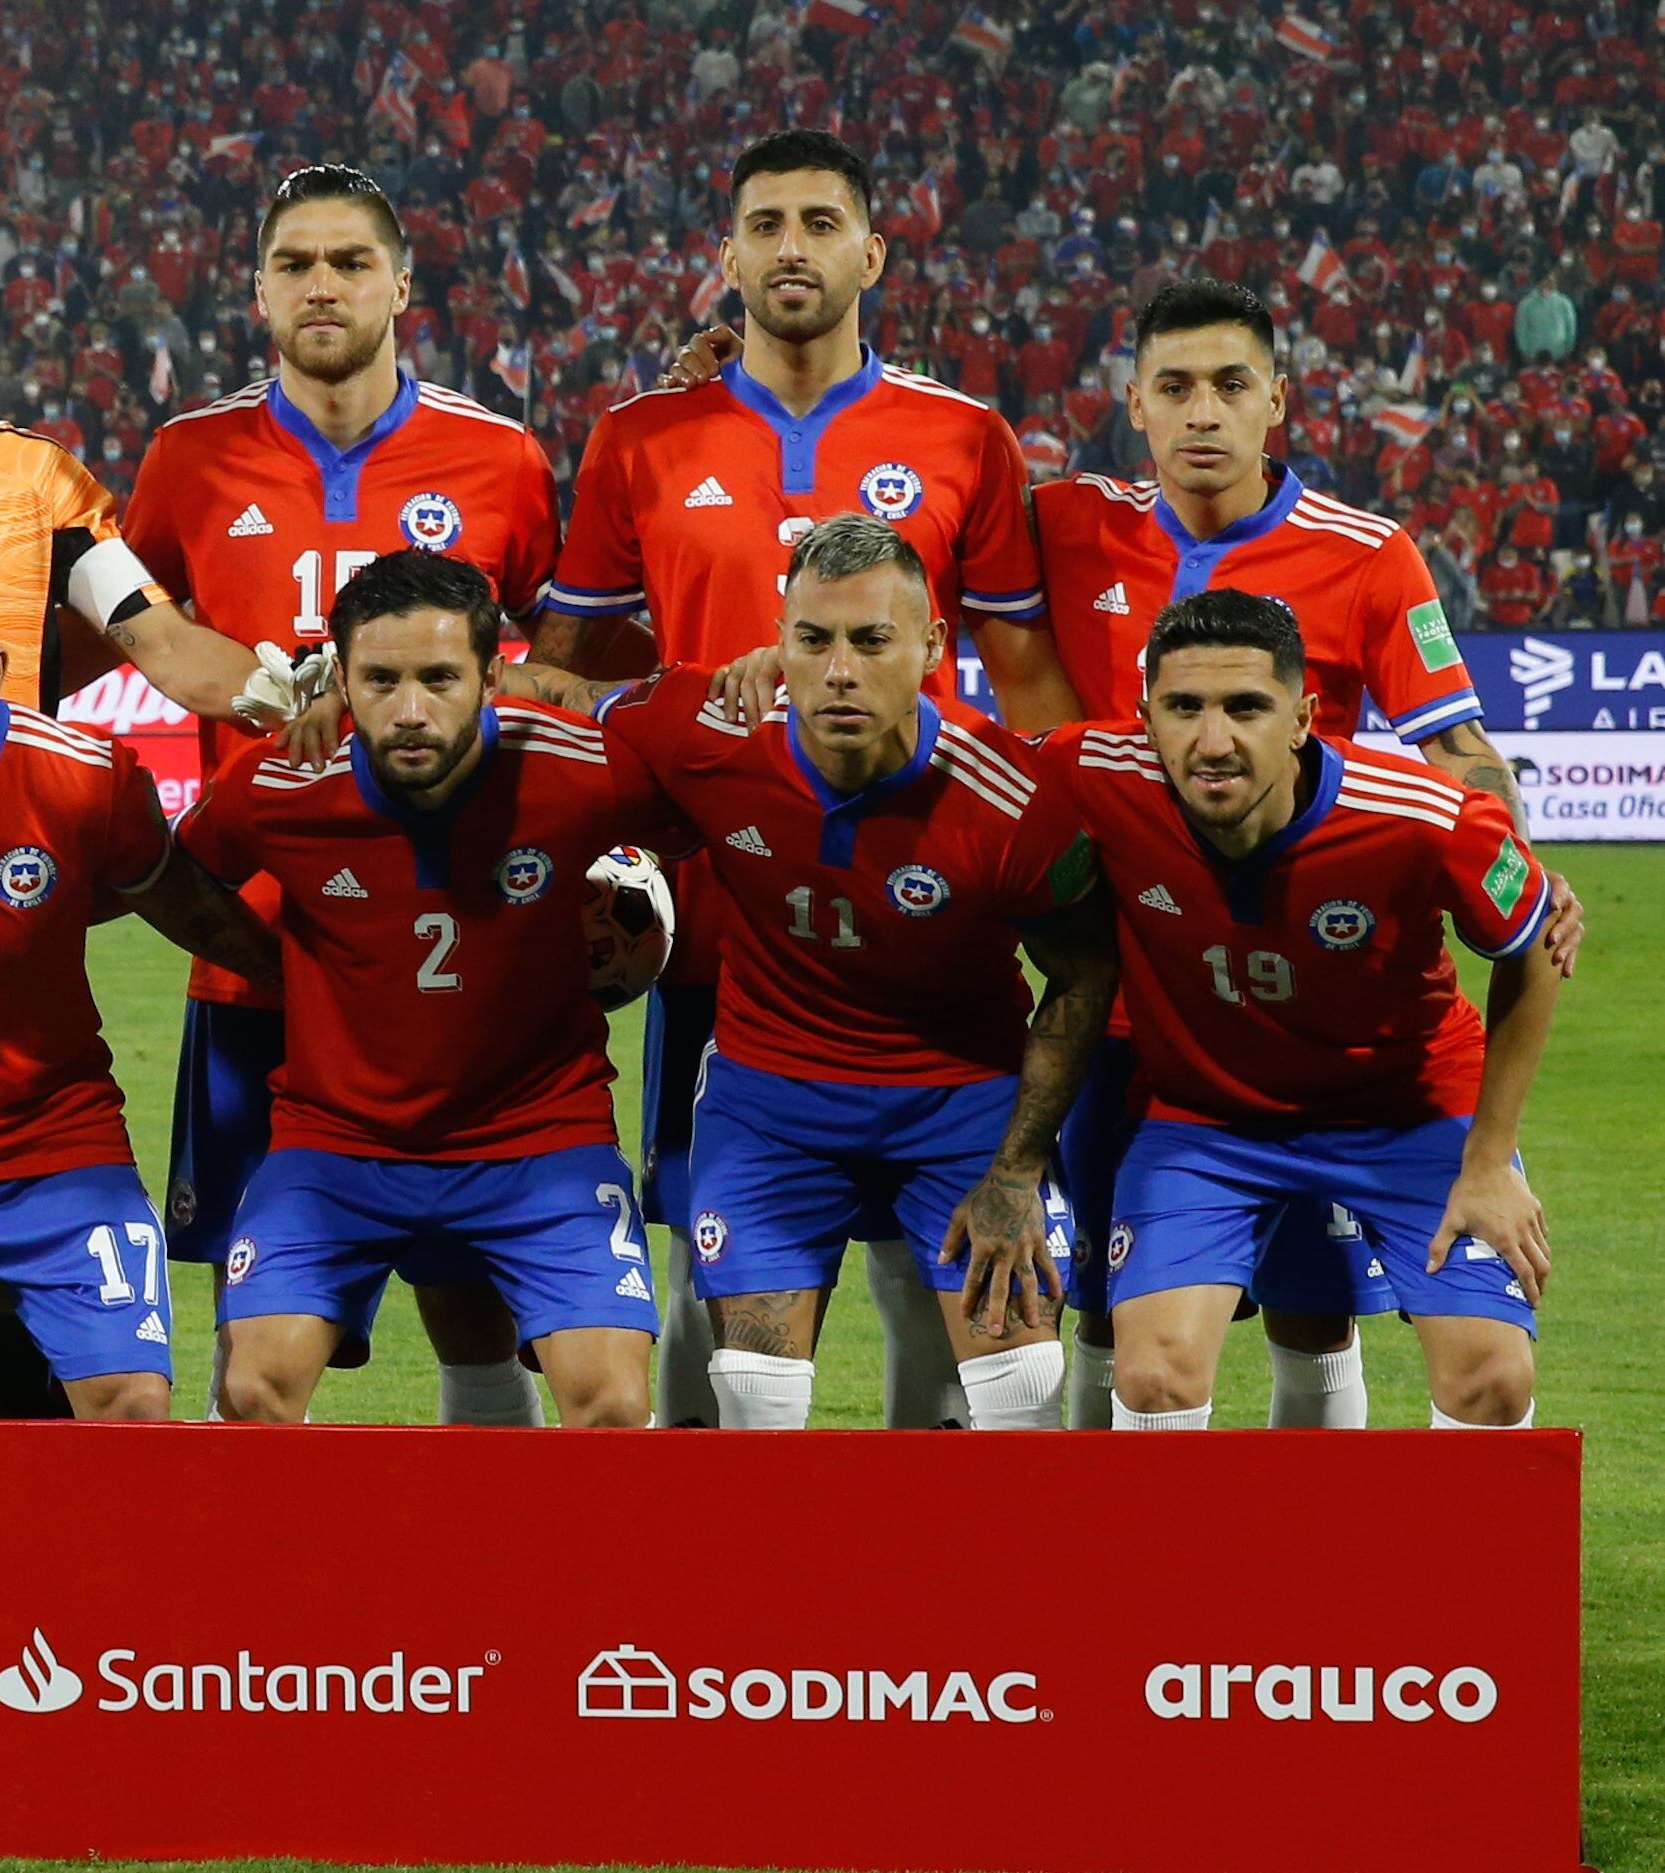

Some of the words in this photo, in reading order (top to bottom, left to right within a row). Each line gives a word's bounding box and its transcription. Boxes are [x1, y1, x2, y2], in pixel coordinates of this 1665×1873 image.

[228, 522, 274, 537] adidas
[684, 494, 733, 508] adidas
[1543, 796, 1608, 818] Casa
[726, 836, 772, 857] adidas
[322, 884, 369, 899] adidas
[785, 886, 863, 948] 11
[1138, 894, 1182, 915] adidas
[414, 913, 462, 994] 2
[1203, 944, 1297, 1007] 19
[595, 1183, 645, 1267] 2
[86, 1221, 160, 1306] 17
[98, 1648, 484, 1714] Santander
[688, 1667, 1038, 1722] SODIMAC
[1145, 1661, 1498, 1722] arauco
